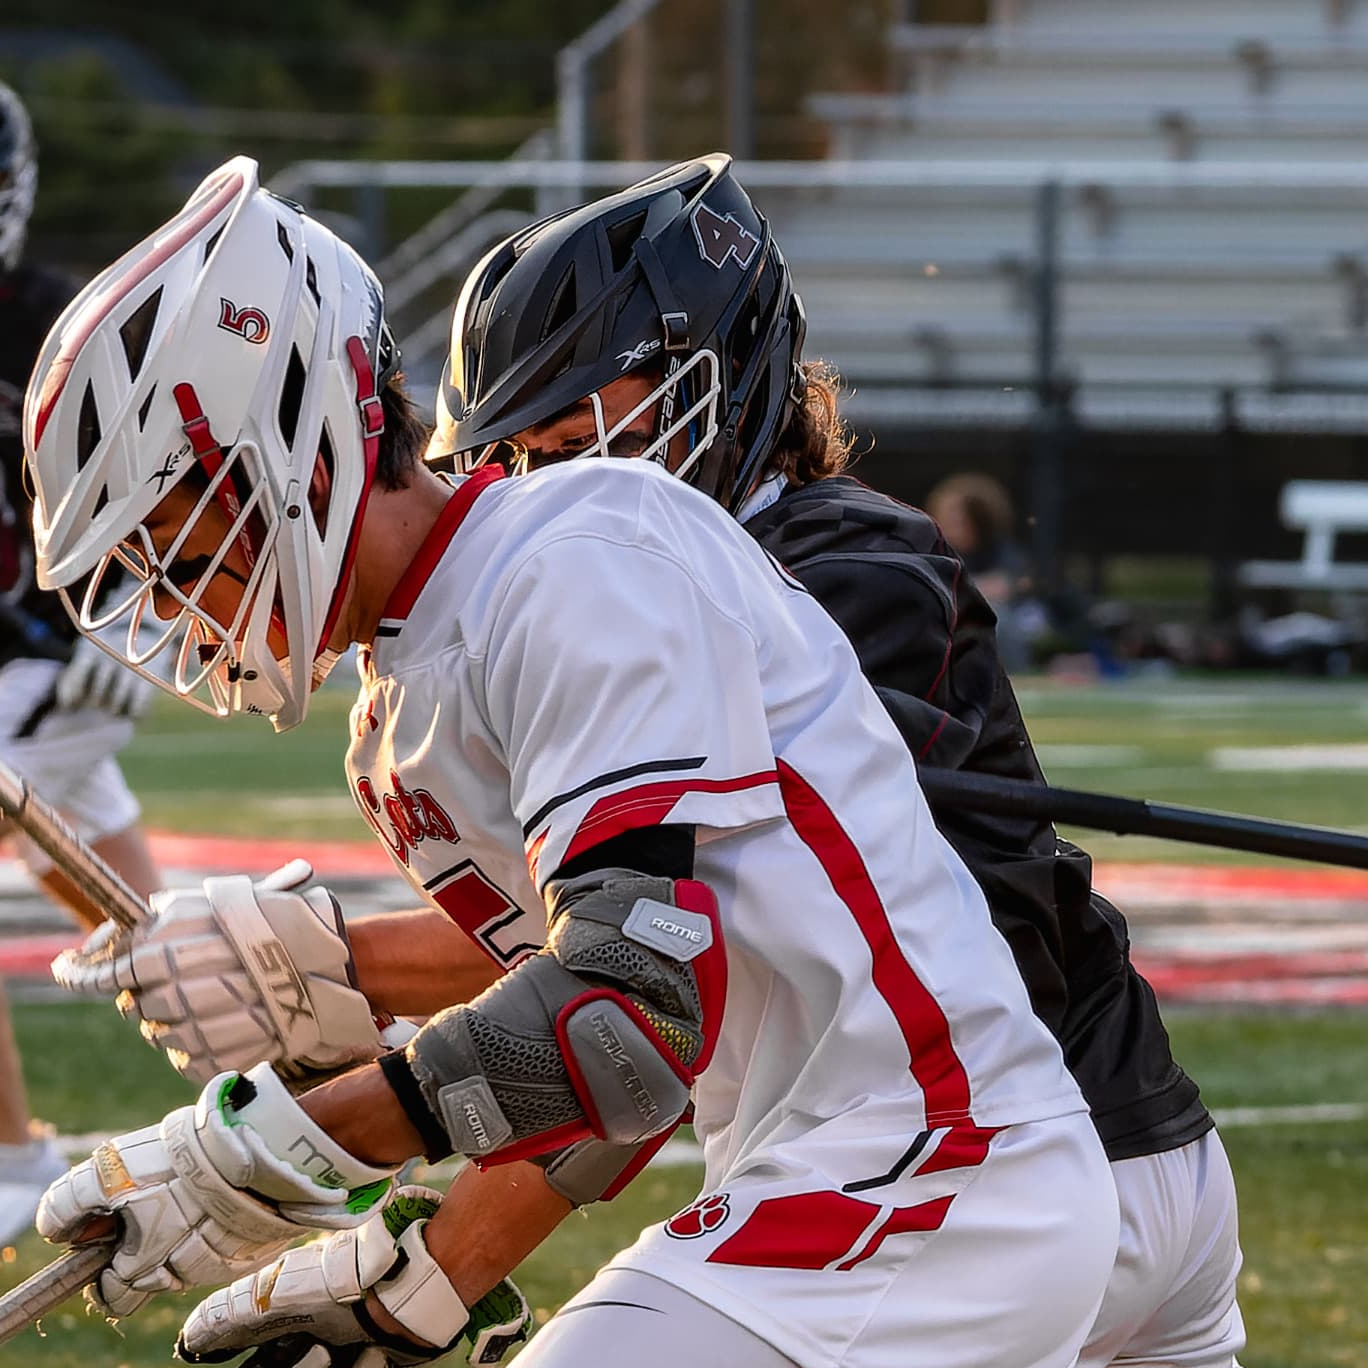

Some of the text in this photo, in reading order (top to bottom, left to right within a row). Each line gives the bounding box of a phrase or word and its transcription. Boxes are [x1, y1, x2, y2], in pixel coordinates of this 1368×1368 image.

[689, 201, 762, 271] 4
[217, 297, 271, 345] 5
[615, 338, 662, 371] XRS
[649, 915, 704, 944] ROME
[246, 940, 316, 1033] STX
[462, 1102, 491, 1150] ROME
